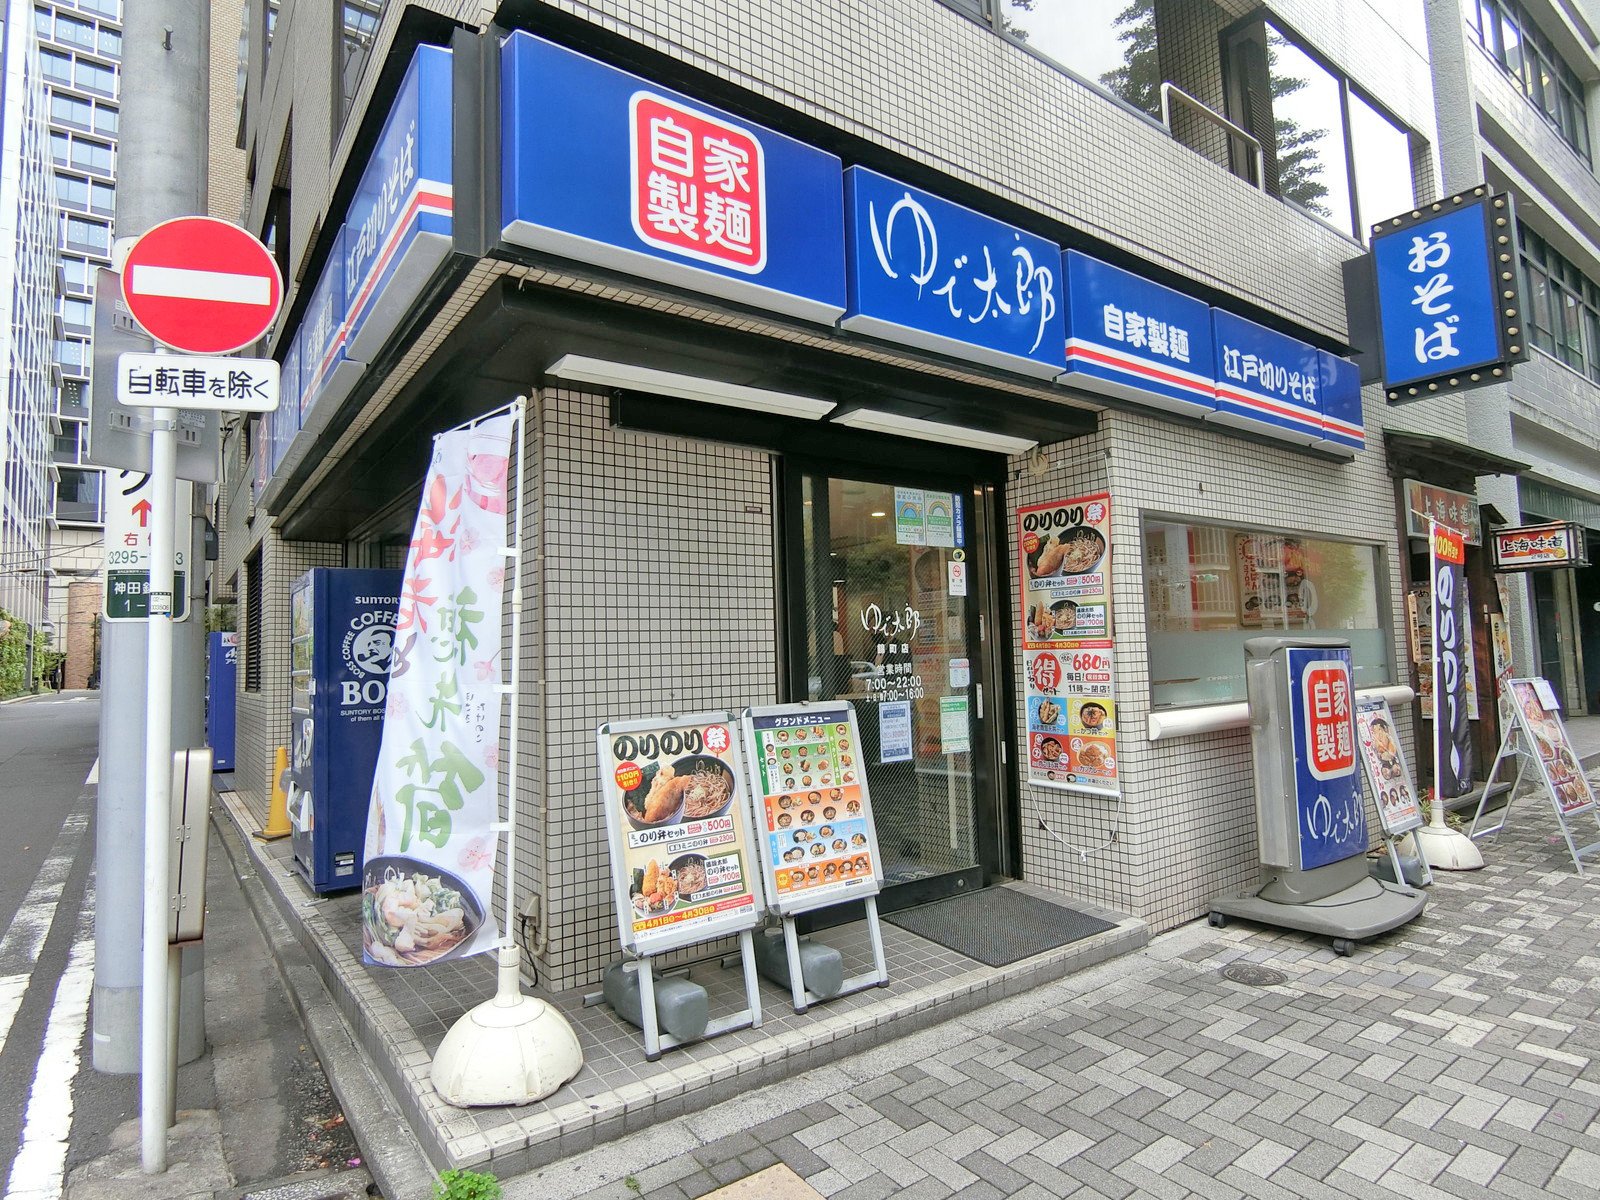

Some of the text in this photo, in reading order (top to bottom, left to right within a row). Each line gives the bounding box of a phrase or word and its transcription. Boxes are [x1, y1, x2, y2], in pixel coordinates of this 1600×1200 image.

[650, 117, 751, 193] 自家
[647, 171, 753, 255] 製麺
[869, 192, 1056, 354] ゆで太郎
[1407, 231, 1460, 364] おそば
[1103, 303, 1190, 363] 自家製麺
[129, 366, 269, 399] 自転車を除く
[1223, 345, 1317, 405] 江戸切りそば
[1023, 506, 1084, 531] のりのり
[1501, 535, 1563, 553] 上海味道
[860, 602, 921, 641] ゆで太郎
[876, 662, 912, 676] 営業時間
[1034, 658, 1056, 688] 得
[1072, 653, 1111, 671] 680円
[1314, 680, 1348, 718] 自家
[774, 715, 831, 727] グランドメニュー
[613, 729, 704, 761] のりのり
[706, 727, 727, 750] 祭
[1316, 721, 1352, 763] 製麺
[706, 819, 731, 833] 500円
